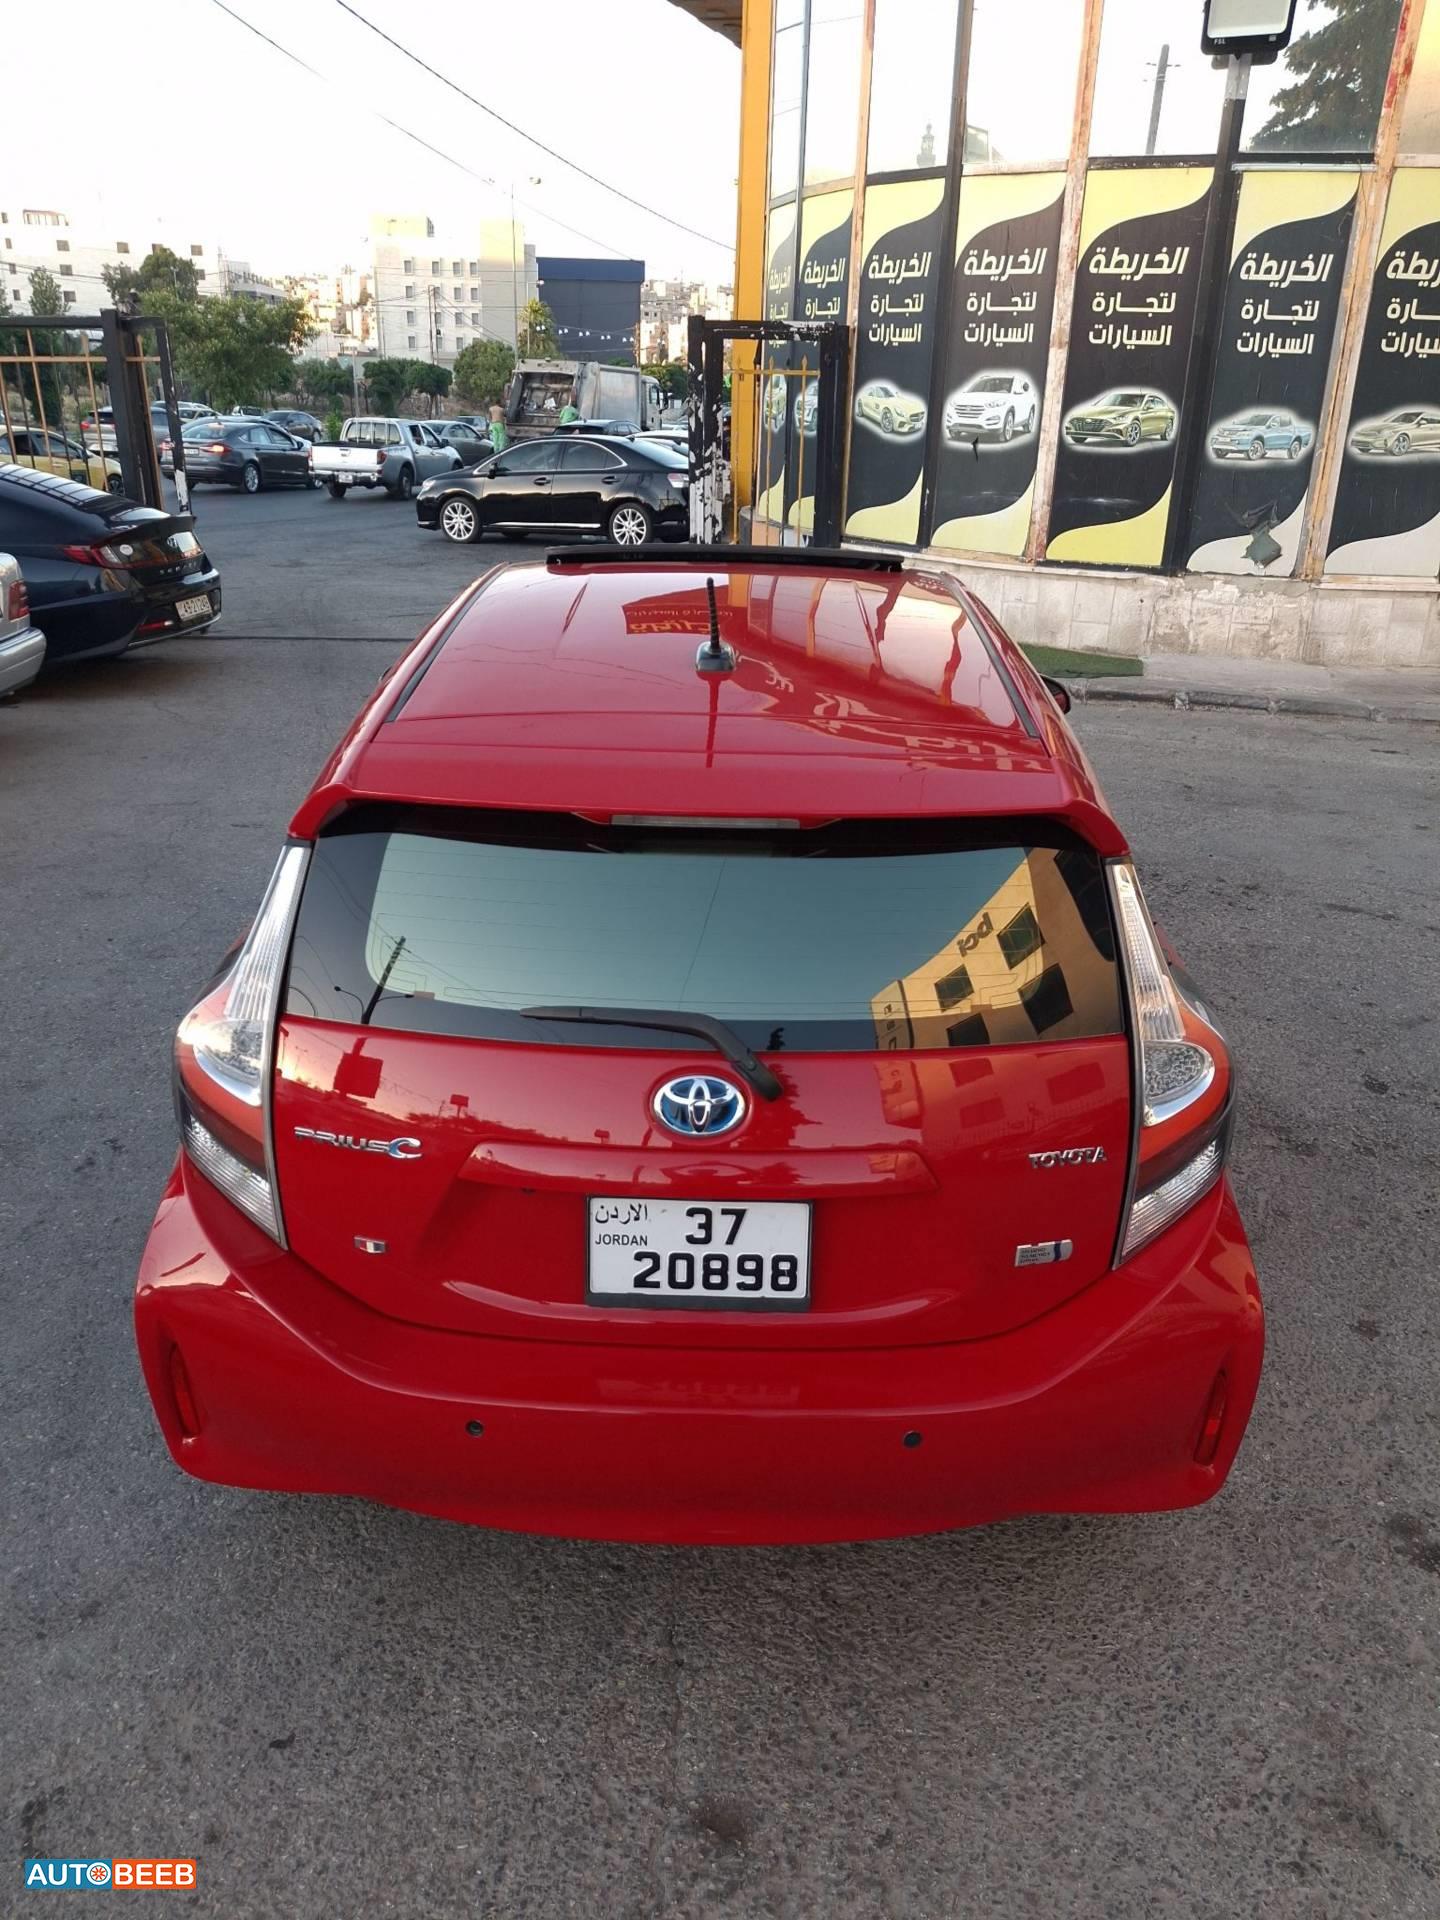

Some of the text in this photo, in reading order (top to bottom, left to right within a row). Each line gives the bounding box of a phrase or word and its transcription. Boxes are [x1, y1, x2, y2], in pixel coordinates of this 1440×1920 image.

[804, 257, 846, 288] الخريطة
[868, 251, 932, 284] الخريطة
[963, 247, 1047, 281] الخريطة
[1089, 247, 1189, 281] الخريطة
[1240, 252, 1334, 288] الخريطة
[805, 296, 841, 319] لتجارة
[870, 293, 924, 317] لتجارة
[966, 292, 1037, 316] لتجارة
[1091, 292, 1176, 317] لتجارة
[1241, 299, 1320, 325] لتجارة
[868, 323, 922, 347] السيارات
[964, 323, 1034, 347] السيارات
[1088, 324, 1173, 349] السيارات
[1236, 332, 1315, 358] السيارات
[1028, 1146, 1107, 1168] TOYOTA
[685, 1207, 747, 1245] 37
[595, 1234, 648, 1247] JORDAN
[633, 1251, 798, 1291] 20898
